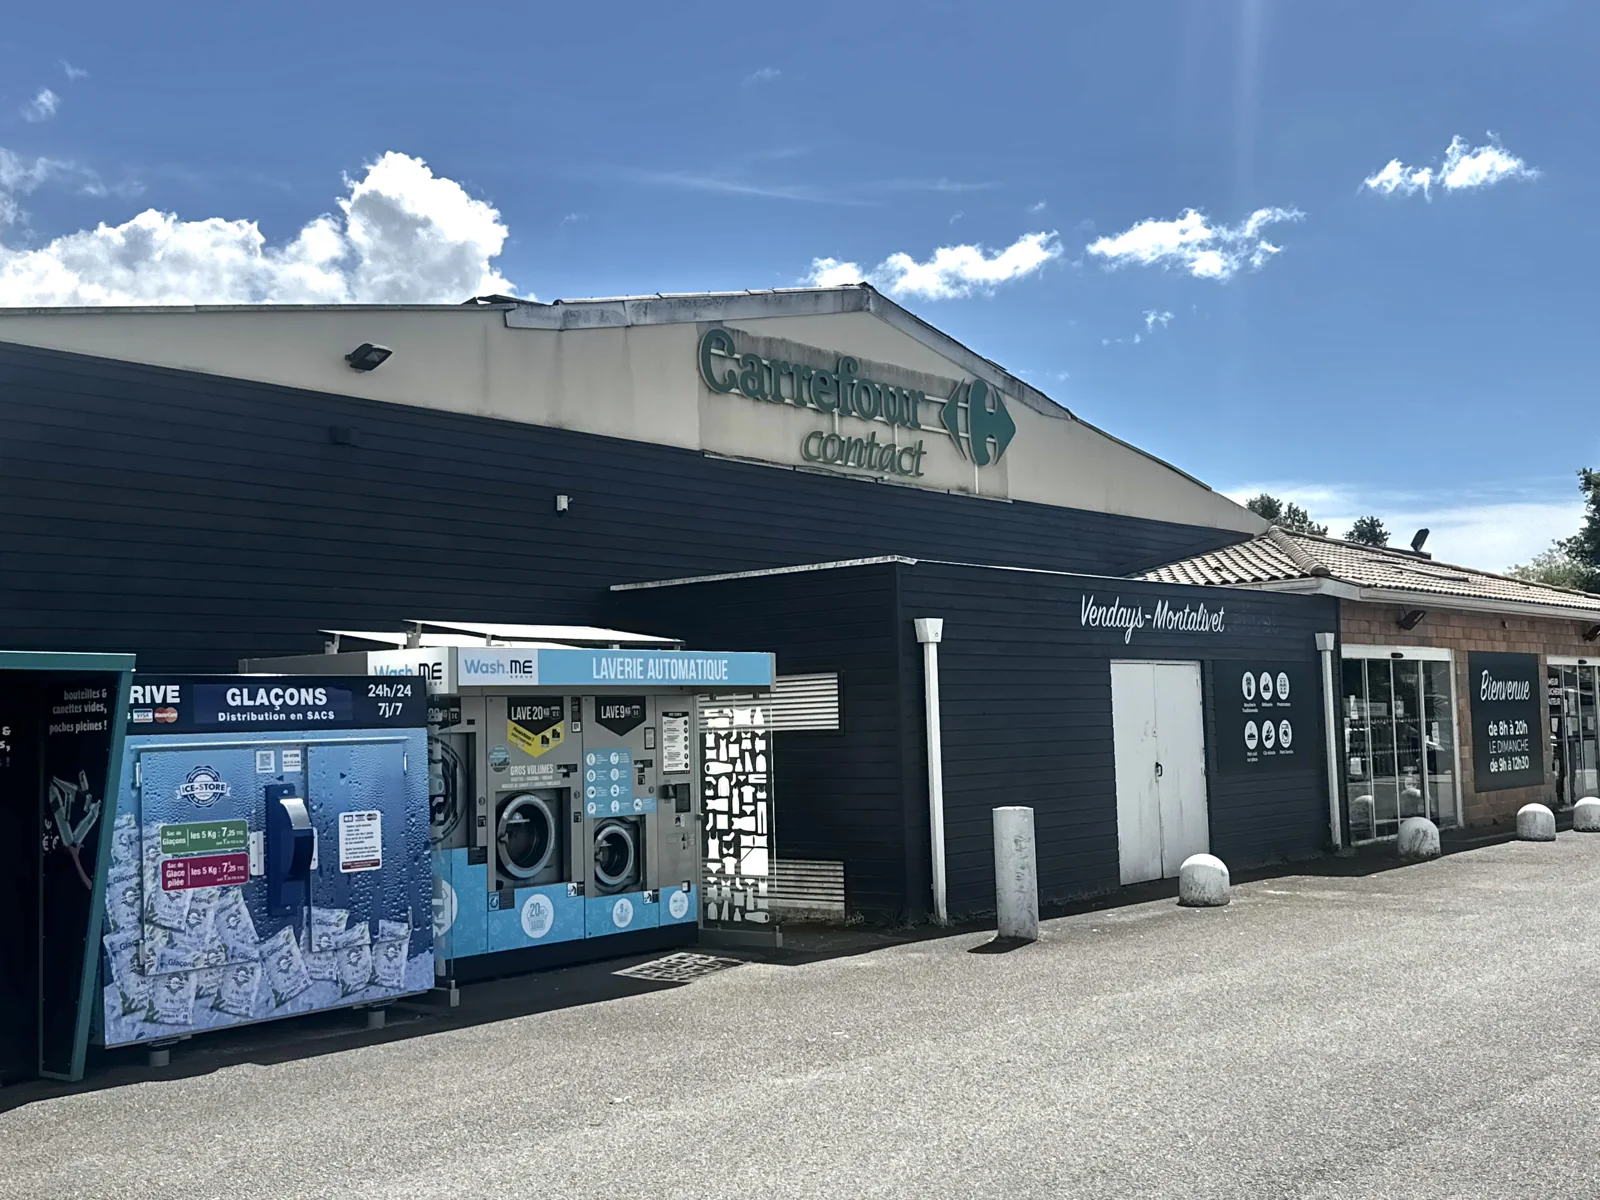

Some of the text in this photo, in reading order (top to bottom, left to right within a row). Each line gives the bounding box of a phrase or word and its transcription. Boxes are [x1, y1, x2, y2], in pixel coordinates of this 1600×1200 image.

[700, 328, 926, 429] Carrefour
[801, 430, 928, 477] contact
[1081, 594, 1225, 644] Vendays-Montalivet
[592, 657, 729, 680] LAVERIE AUTOMATIQUE
[367, 684, 412, 698] 24h/24
[1480, 669, 1531, 701] Bienvenue
[63, 688, 107, 700] bouteilles &
[226, 687, 328, 711] GLAÇONS
[52, 701, 107, 715] canettes vides,
[377, 702, 403, 719] 7j/7
[511, 706, 532, 720] LAVE
[532, 706, 543, 720] 20
[601, 705, 620, 719] LAVE
[620, 705, 625, 718] 9
[218, 712, 286, 722] Distribution
[307, 711, 335, 720] SACS
[2, 726, 12, 736] &
[49, 720, 107, 735] poches pleines !
[1488, 719, 1529, 737] de 8h à 20h
[1489, 739, 1530, 754] LE DIMANCHE
[510, 763, 554, 776] GROS VOLUMES
[1489, 755, 1530, 773] de 9h à 12h30
[181, 783, 226, 793] ICE-STORE
[162, 837, 187, 846] Glaçons
[190, 831, 201, 840] les
[201, 831, 207, 839] 5
[207, 830, 217, 840] Kg
[166, 869, 186, 878] Glace
[191, 867, 202, 876] les
[202, 866, 208, 875] 5
[208, 865, 218, 875] Kg
[113, 872, 139, 884] Glaçon
[167, 878, 185, 889] pilée
[529, 902, 540, 916] 20
[619, 903, 624, 913] 9
[315, 918, 339, 928] Glaçons
[168, 958, 195, 968] Glaçons
